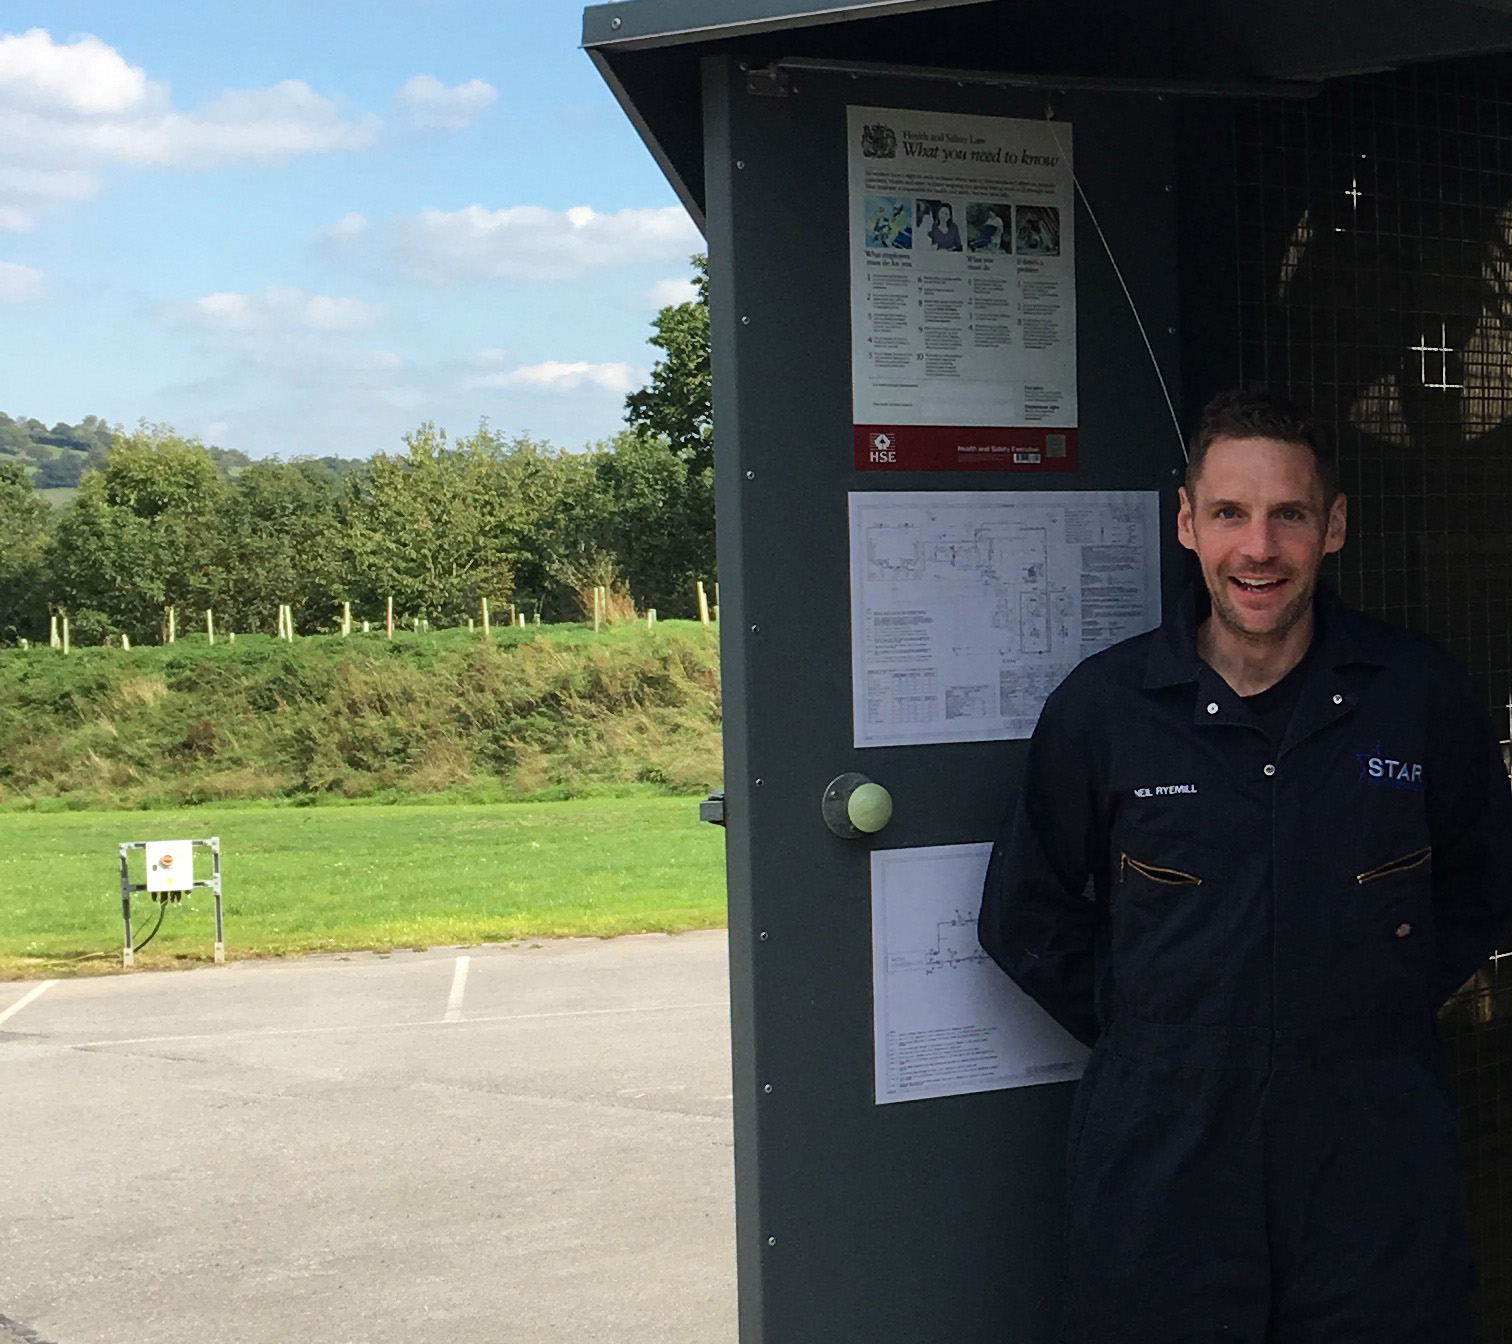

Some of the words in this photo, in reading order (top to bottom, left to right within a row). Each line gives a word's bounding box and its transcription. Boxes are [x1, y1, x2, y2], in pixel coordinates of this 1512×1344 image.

[930, 133, 944, 142] and
[969, 135, 986, 144] Law
[903, 141, 939, 158] What
[942, 149, 967, 163] you
[970, 147, 1002, 163] need
[1004, 150, 1017, 164] to
[1021, 149, 1059, 167] know
[870, 452, 896, 463] HSE
[1368, 757, 1422, 784] STAR
